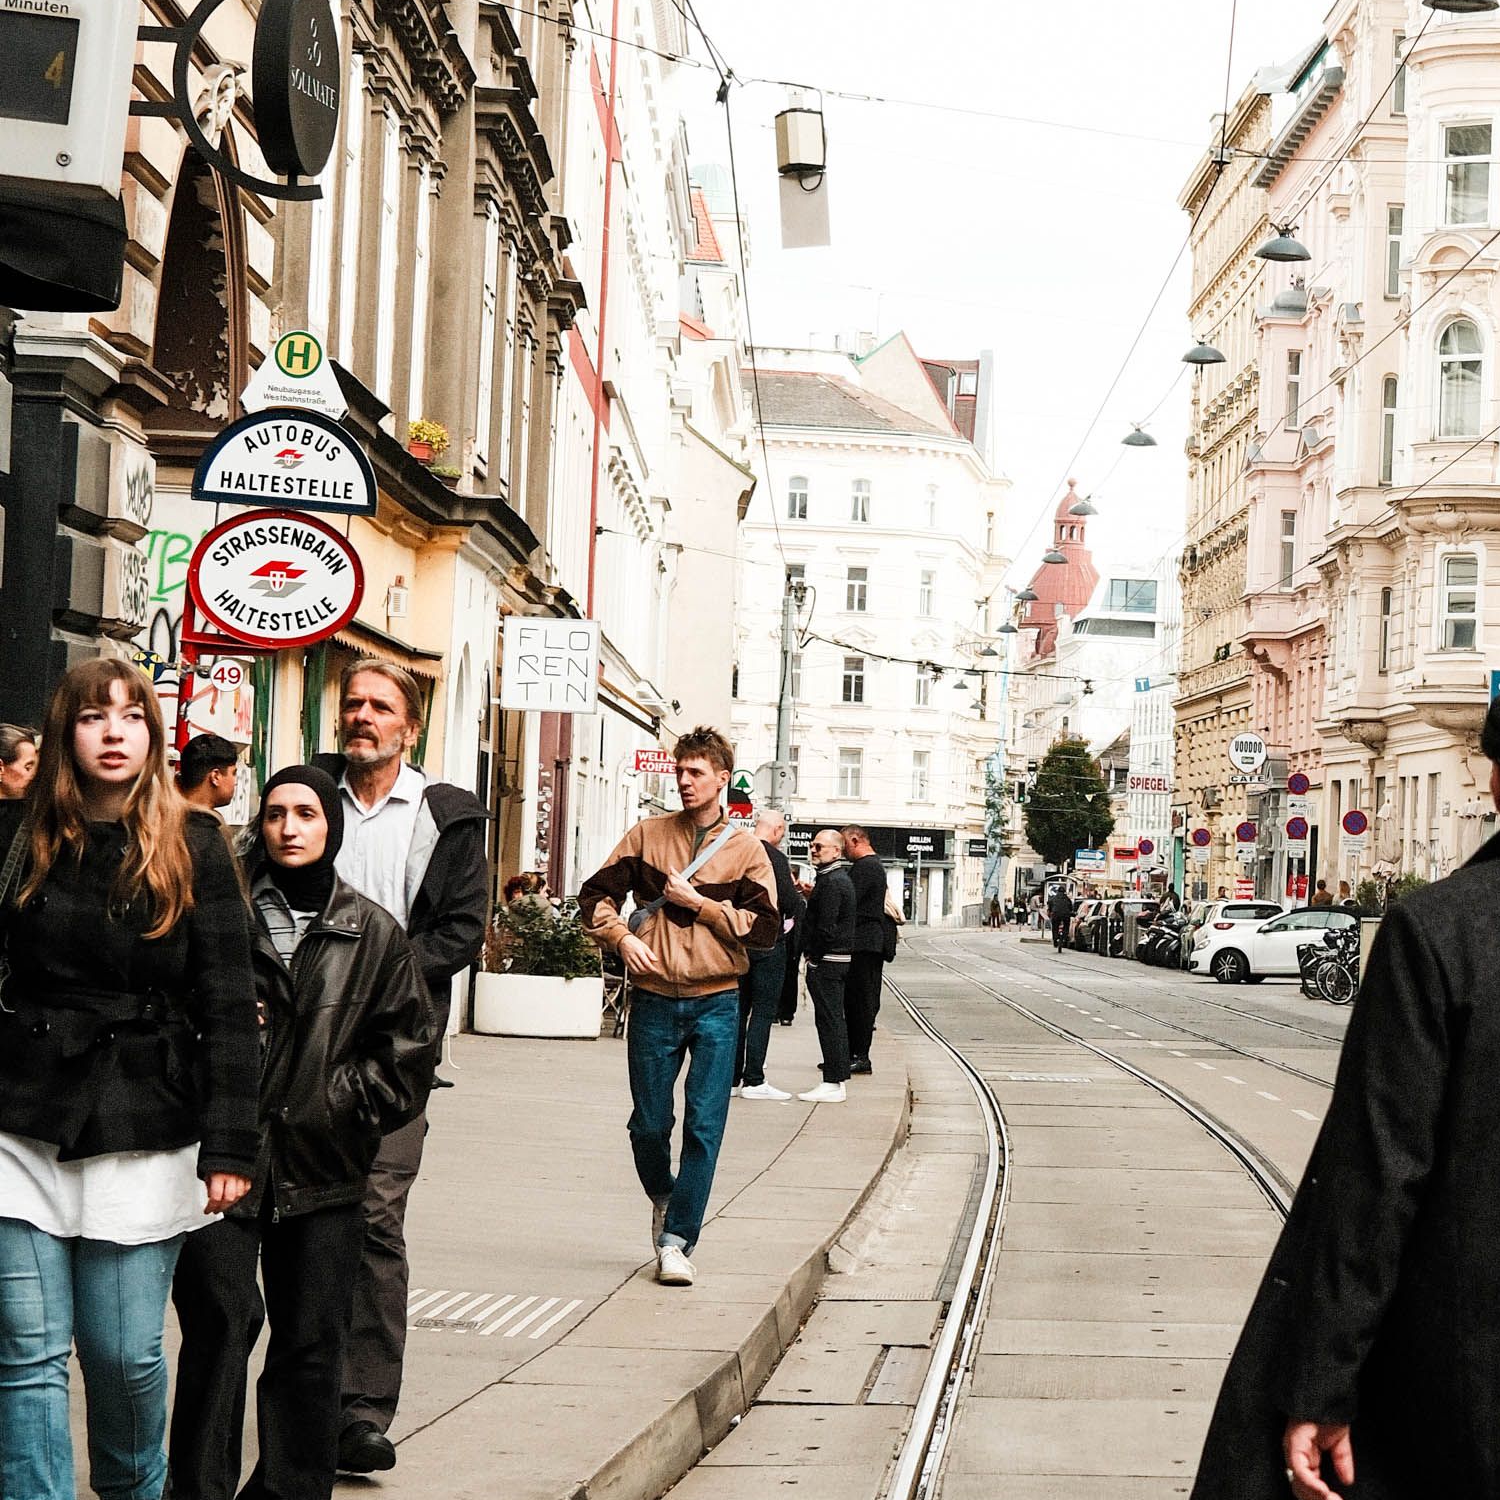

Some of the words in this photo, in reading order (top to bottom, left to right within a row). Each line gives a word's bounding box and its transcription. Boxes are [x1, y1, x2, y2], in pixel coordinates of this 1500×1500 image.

[286, 340, 311, 370] H
[263, 393, 326, 405] Westbahnstraße
[244, 425, 341, 462] AUTOBUS
[220, 471, 354, 500] HALTESTELLE
[212, 526, 348, 576] STRASSENBAHN
[214, 589, 338, 632] HALTESTELLE
[519, 627, 590, 651] FLO
[213, 667, 242, 684] 49
[518, 654, 589, 678] REN
[516, 682, 587, 703] TIN
[1234, 741, 1262, 753] VOODOO
[1130, 776, 1168, 791] SPIEGEL
